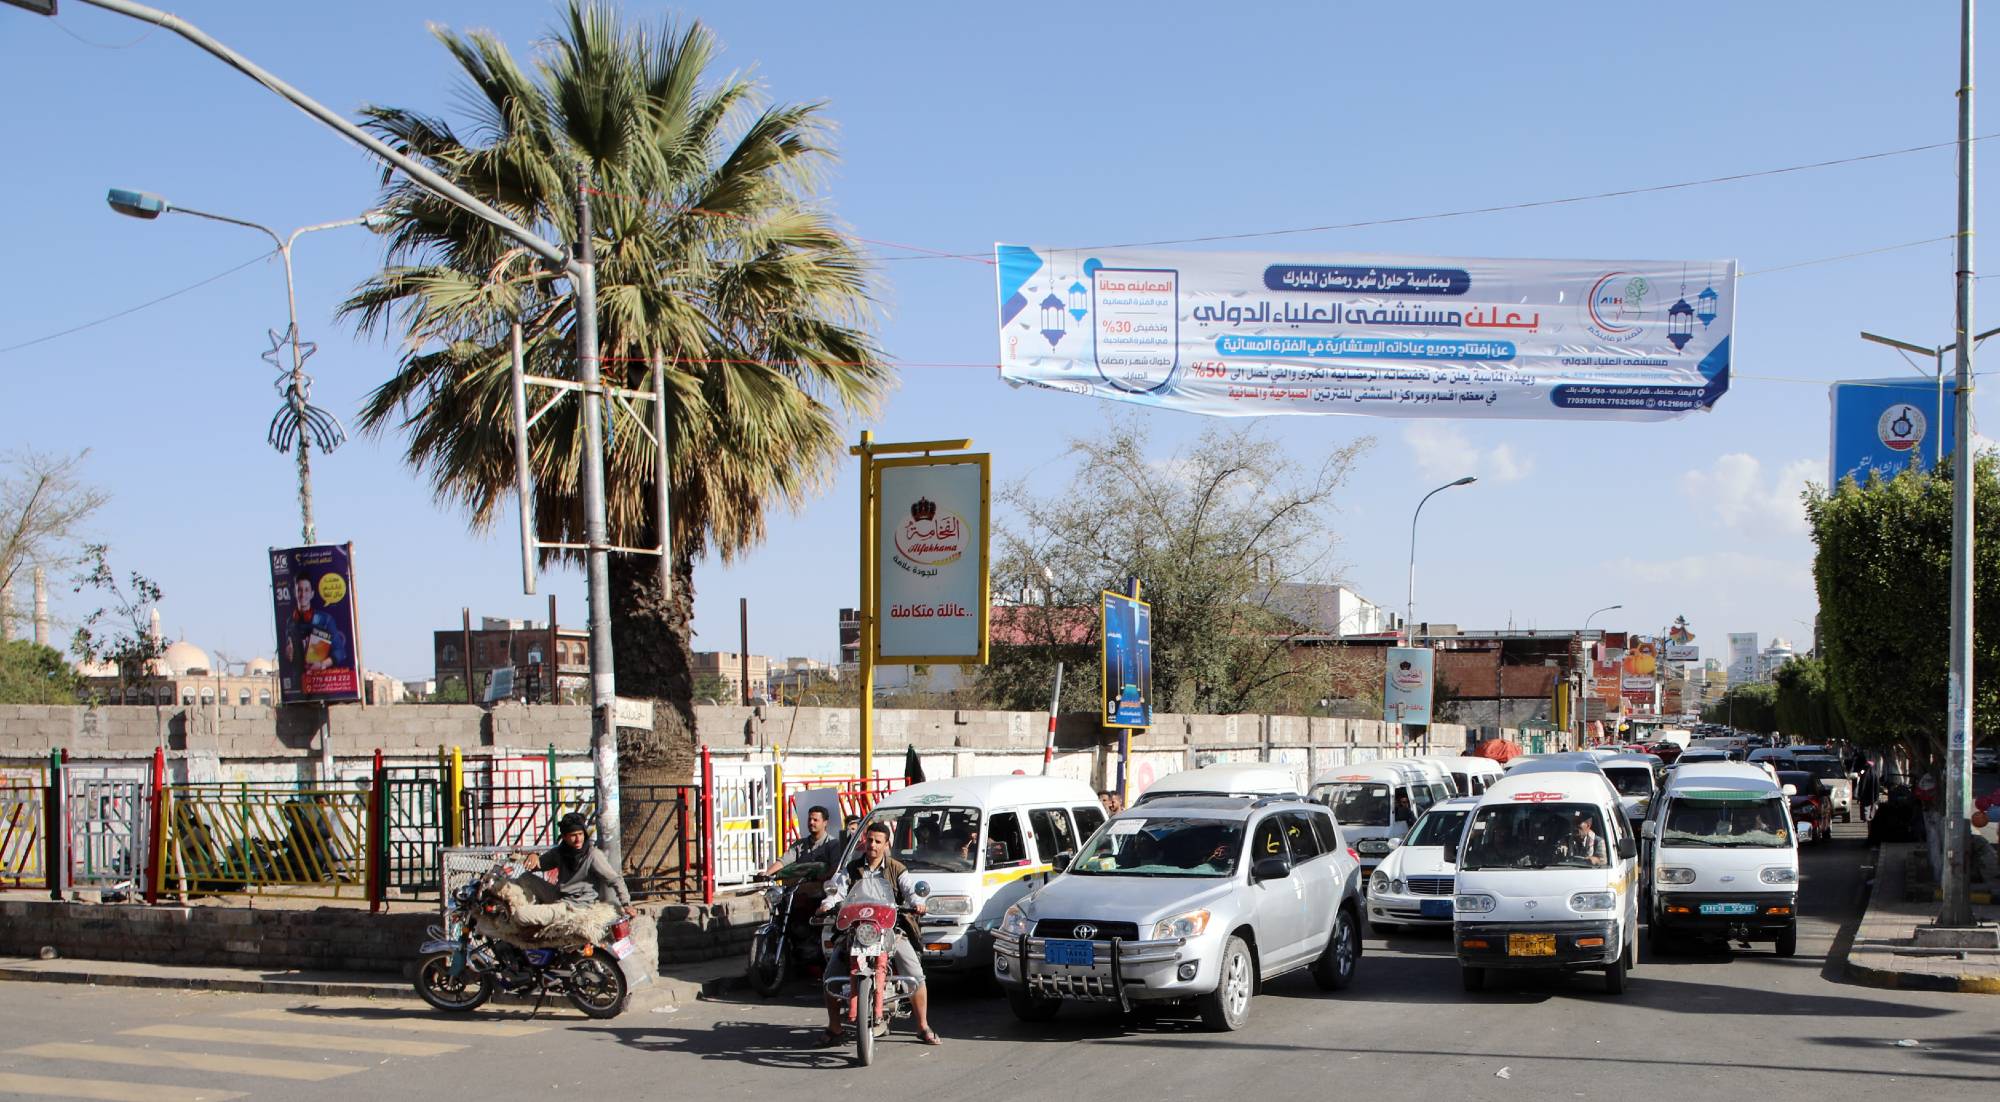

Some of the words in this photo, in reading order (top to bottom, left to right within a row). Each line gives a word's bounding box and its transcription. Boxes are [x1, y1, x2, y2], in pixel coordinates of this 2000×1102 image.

[1282, 270, 1318, 288] المبارك
[1319, 271, 1353, 288] رمضان
[1353, 269, 1377, 289] شهر
[1377, 273, 1405, 290] حلول
[1407, 272, 1450, 292] بمناسبة
[1193, 301, 1270, 327] الدولي
[1272, 302, 1342, 329] العلياء
[1345, 302, 1462, 328] مستشفى
[1464, 306, 1539, 333] يعلن
[1223, 337, 1272, 353] المسائية
[1273, 339, 1306, 354] الفترة
[1306, 340, 1323, 356] في
[1386, 341, 1425, 356] عياداته
[1426, 344, 1456, 357] جميع
[1491, 344, 1509, 357] عن
[1432, 371, 1447, 384] عن
[1449, 371, 1471, 385] يعلن
[1473, 370, 1507, 385] المناسبة
[1269, 385, 1312, 400] الصباحية
[1354, 386, 1397, 403] المستشفى
[1397, 389, 1430, 404] ومراكز
[1485, 392, 1498, 407] في
[907, 543, 958, 556] Alfakhama
[890, 602, 934, 618] متكاملة
